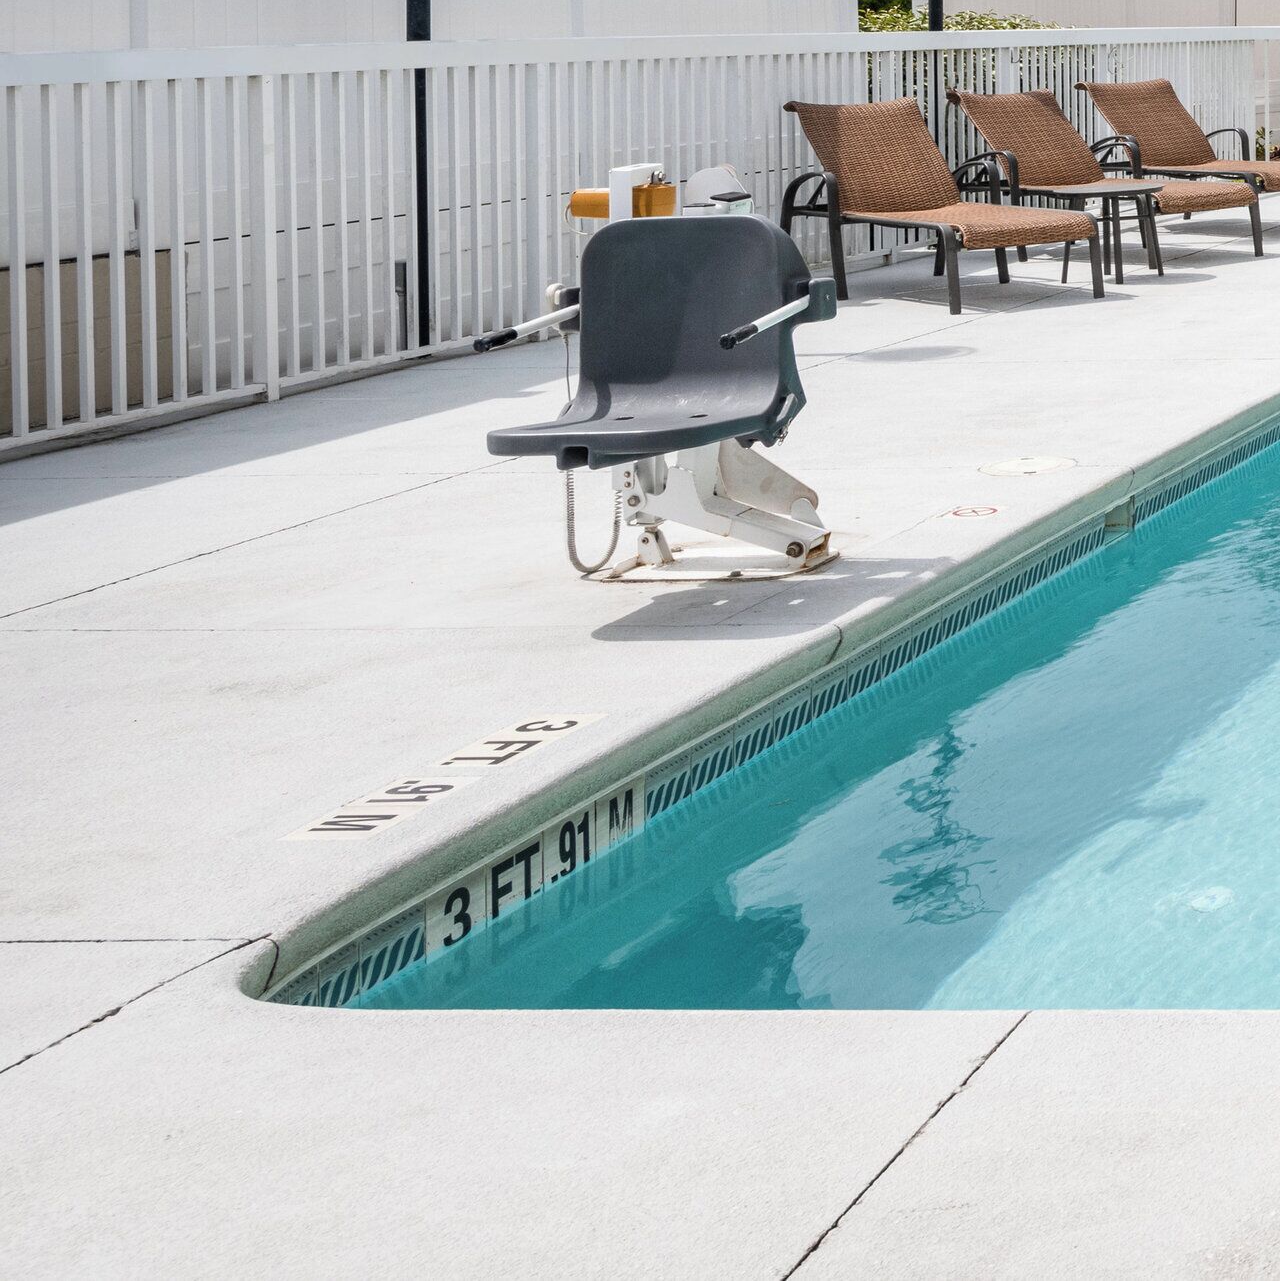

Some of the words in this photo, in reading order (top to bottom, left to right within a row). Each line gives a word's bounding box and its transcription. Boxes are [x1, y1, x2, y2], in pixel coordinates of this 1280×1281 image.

[515, 720, 578, 732] 3
[308, 814, 399, 831] M
[443, 886, 472, 947] 3
[551, 811, 590, 883] .91
[608, 788, 633, 843] M
